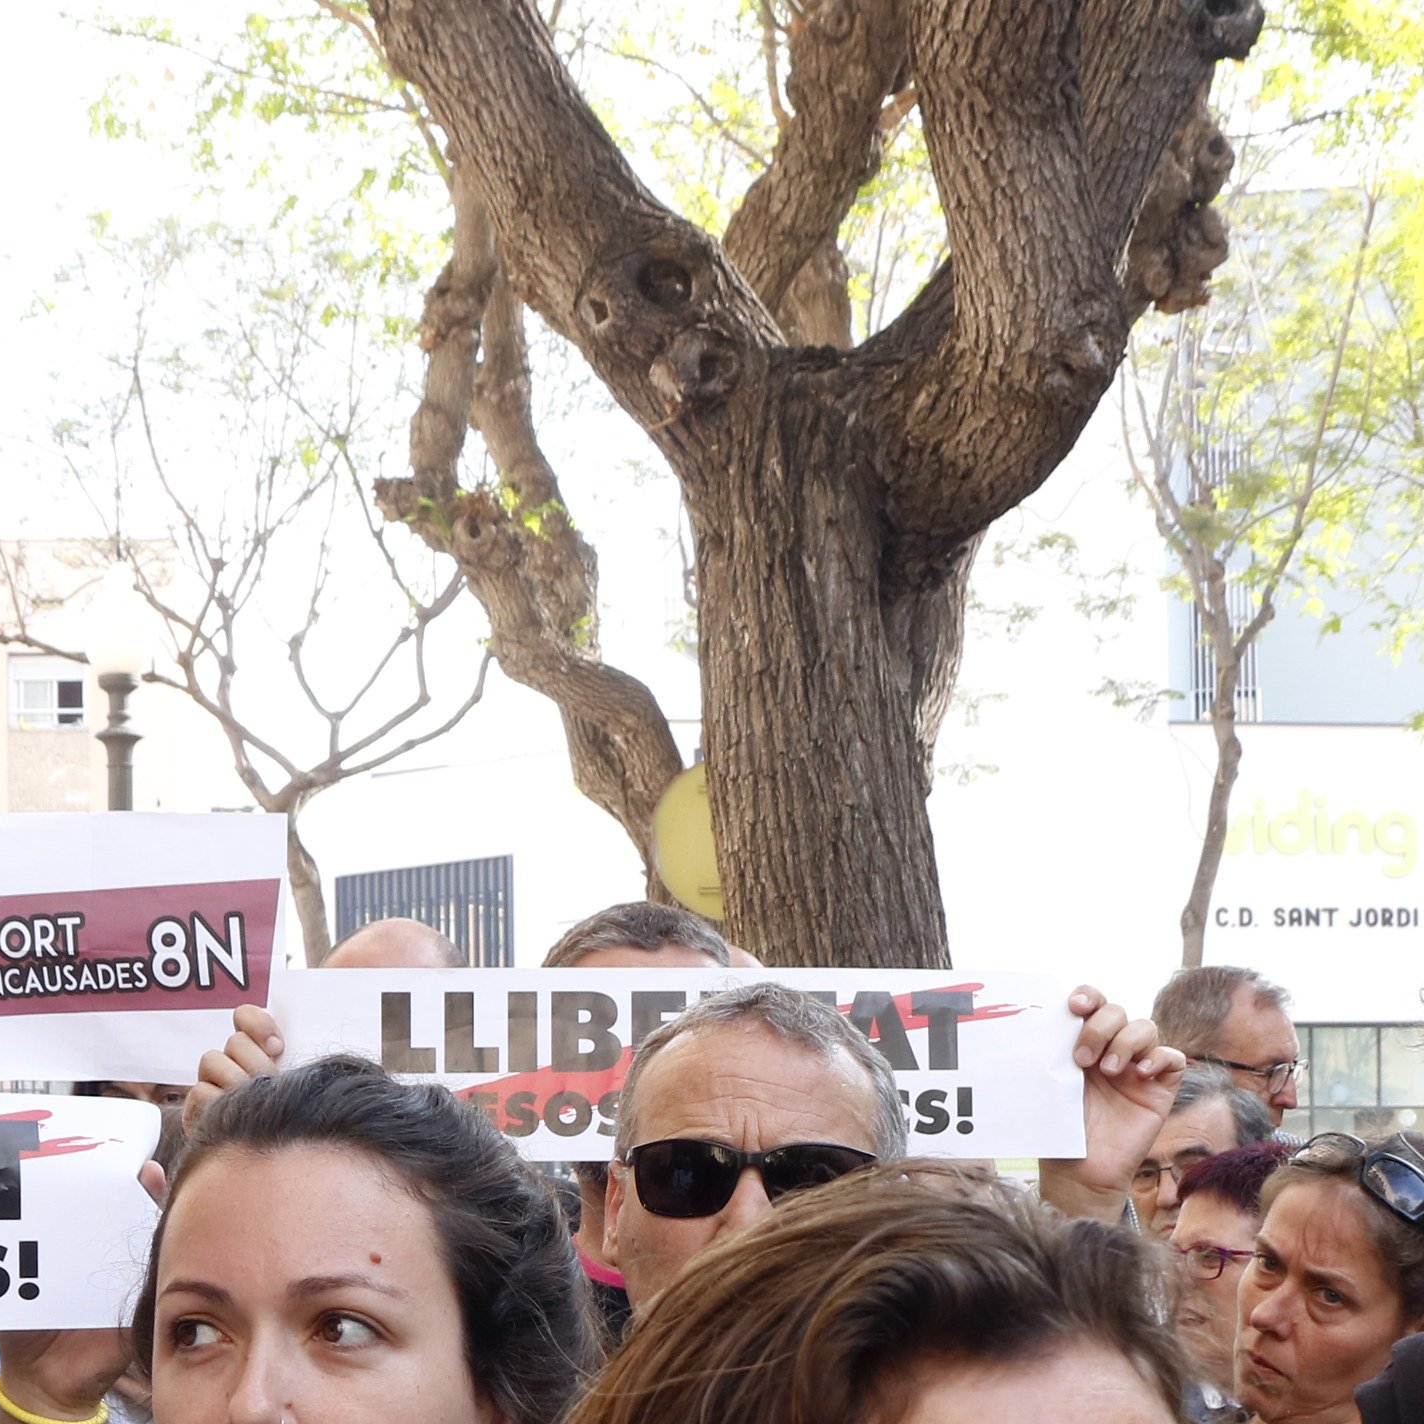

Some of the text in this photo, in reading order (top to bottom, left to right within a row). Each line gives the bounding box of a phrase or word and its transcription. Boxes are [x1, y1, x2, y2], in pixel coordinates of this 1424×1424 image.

[1215, 907, 1420, 929] C.D. SANT JORDI
[150, 915, 246, 988] 8N
